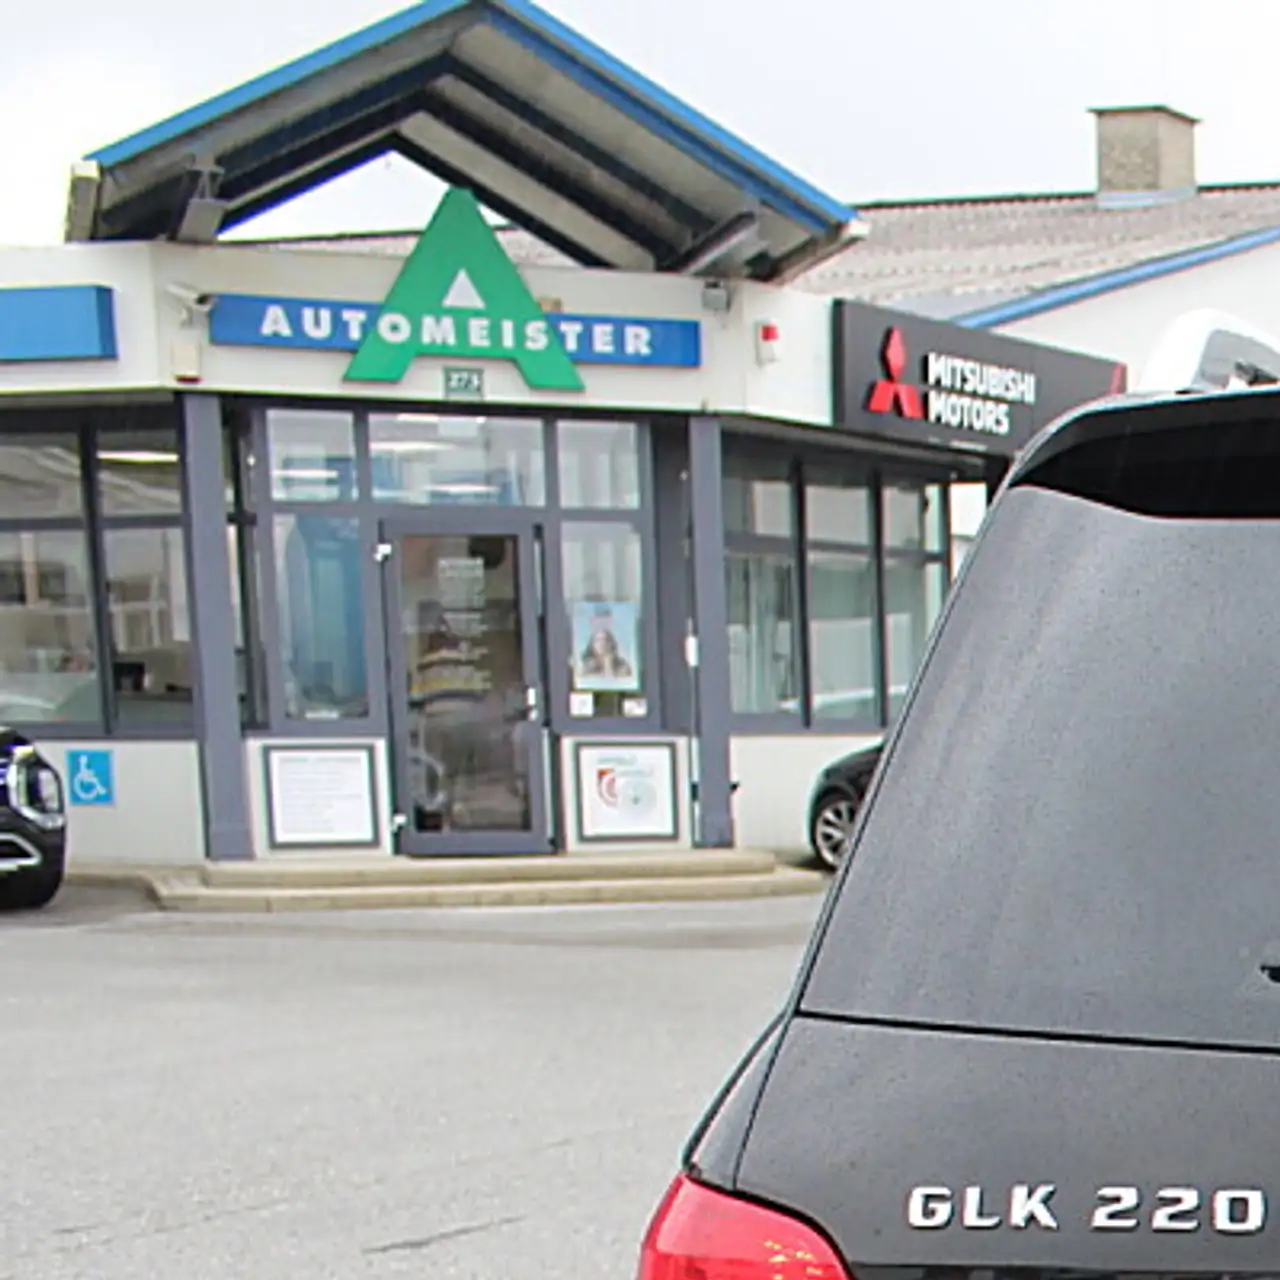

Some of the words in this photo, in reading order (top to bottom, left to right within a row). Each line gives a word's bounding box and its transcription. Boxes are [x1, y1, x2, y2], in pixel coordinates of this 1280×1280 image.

[260, 304, 653, 357] AUTOMEISTER
[927, 351, 1036, 404] MITSUBISHI
[927, 391, 1010, 436] MOTORS
[907, 1184, 1059, 1231] GLK
[1090, 1187, 1267, 1233] 220
